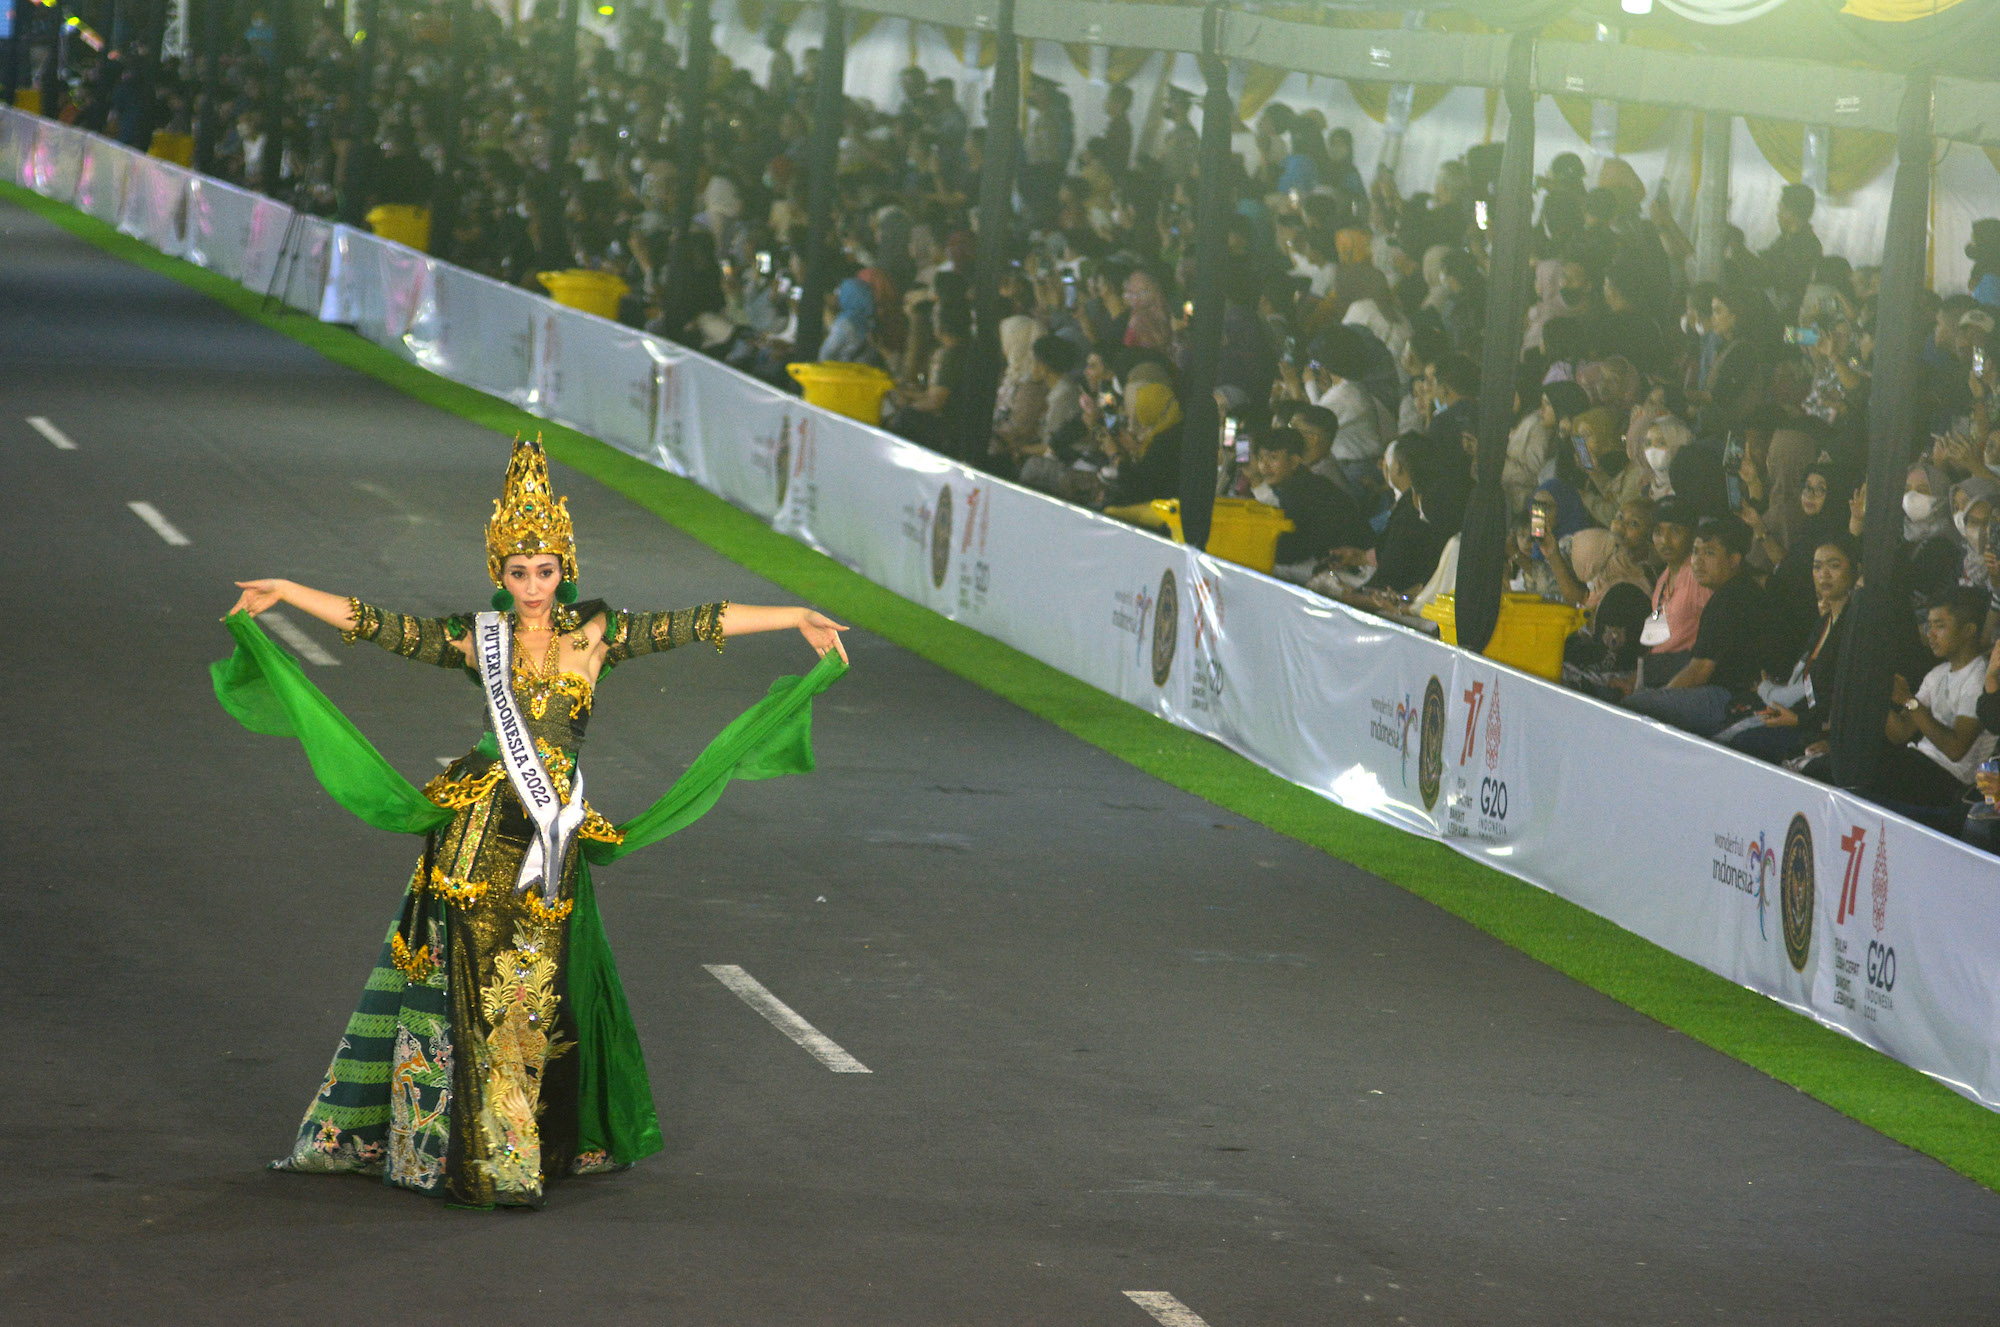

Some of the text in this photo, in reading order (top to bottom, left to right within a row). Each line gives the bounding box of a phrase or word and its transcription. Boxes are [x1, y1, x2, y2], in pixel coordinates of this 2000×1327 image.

[484, 623, 551, 808] PUTERI INDONESIA 2022
[1481, 776, 1507, 820] G20
[1712, 853, 1753, 894] indonesia
[1867, 939, 1896, 992] G20
